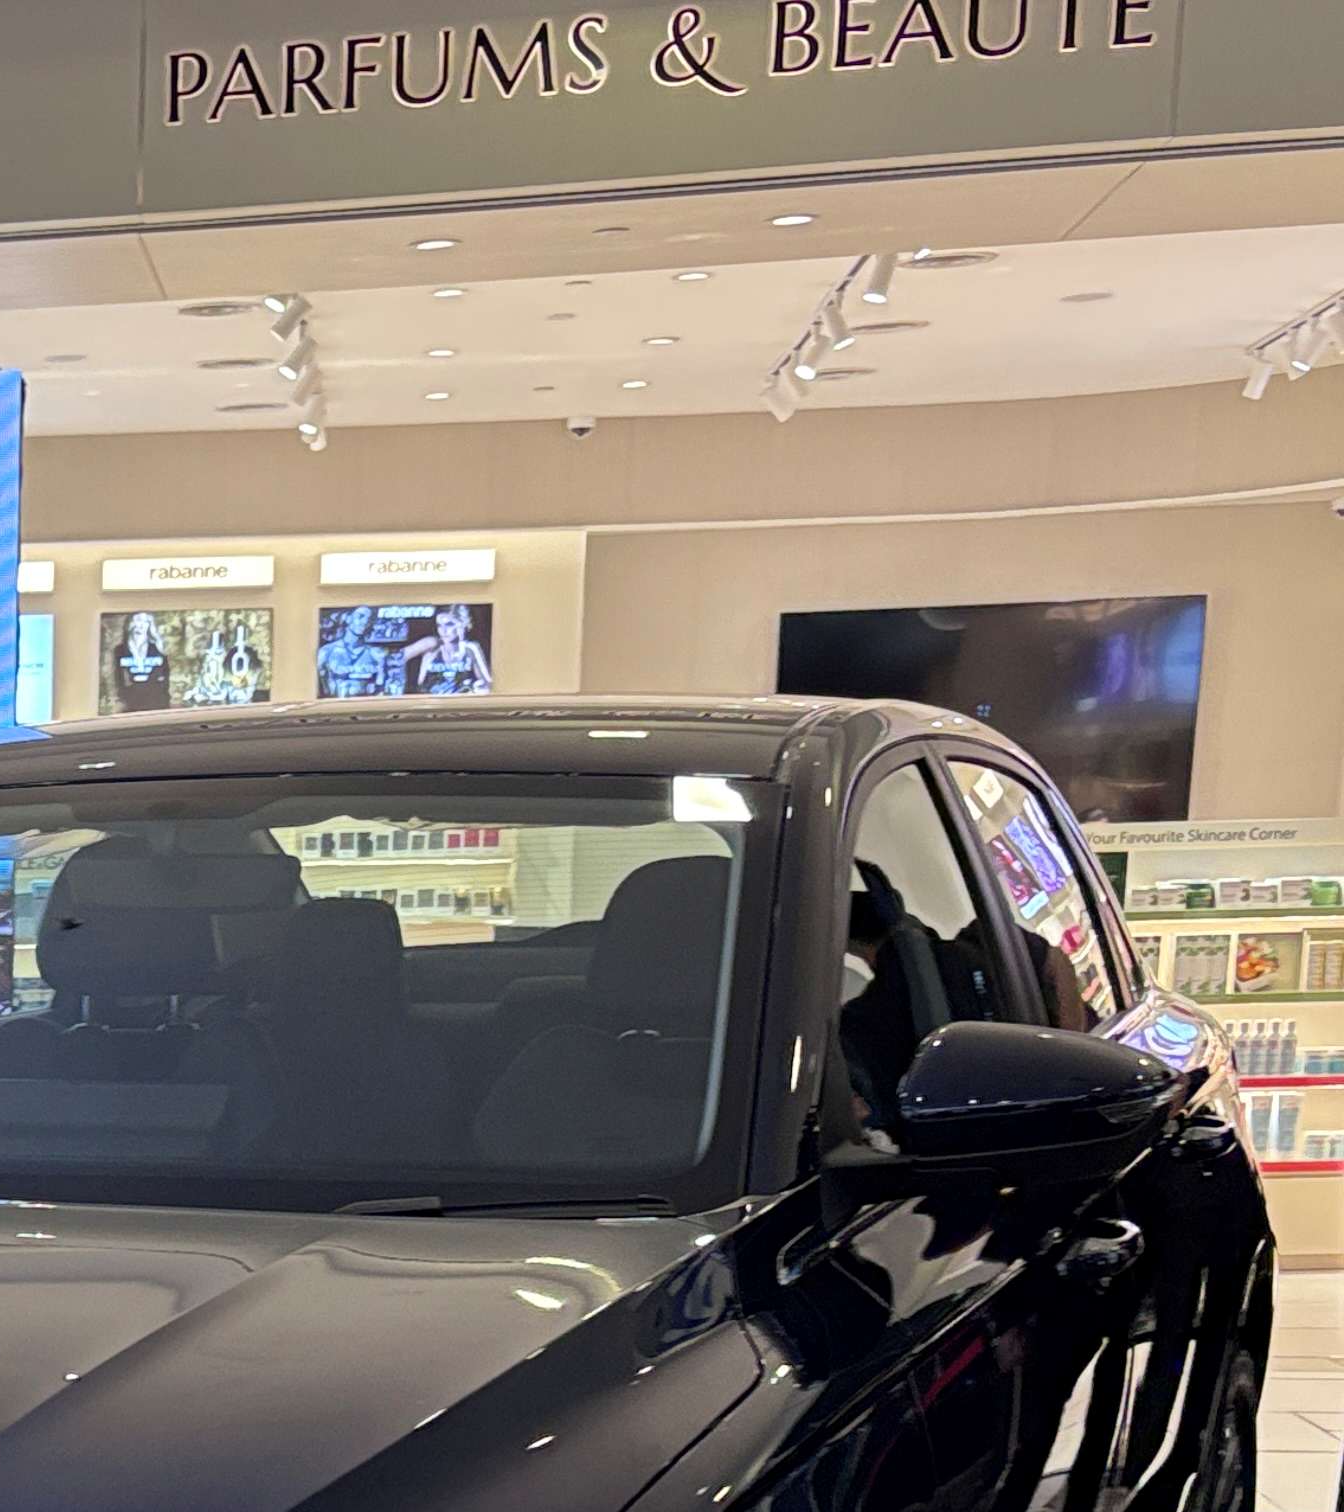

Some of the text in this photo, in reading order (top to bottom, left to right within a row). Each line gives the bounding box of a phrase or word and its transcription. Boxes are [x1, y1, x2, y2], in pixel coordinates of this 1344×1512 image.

[164, 13, 609, 127] PARFUMS
[649, 6, 748, 97] &
[149, 564, 228, 580] rabanne
[368, 559, 447, 574] rabanne
[1120, 829, 1184, 844] Favourite
[1187, 828, 1246, 843] Skincare
[1249, 827, 1297, 841] Corner
